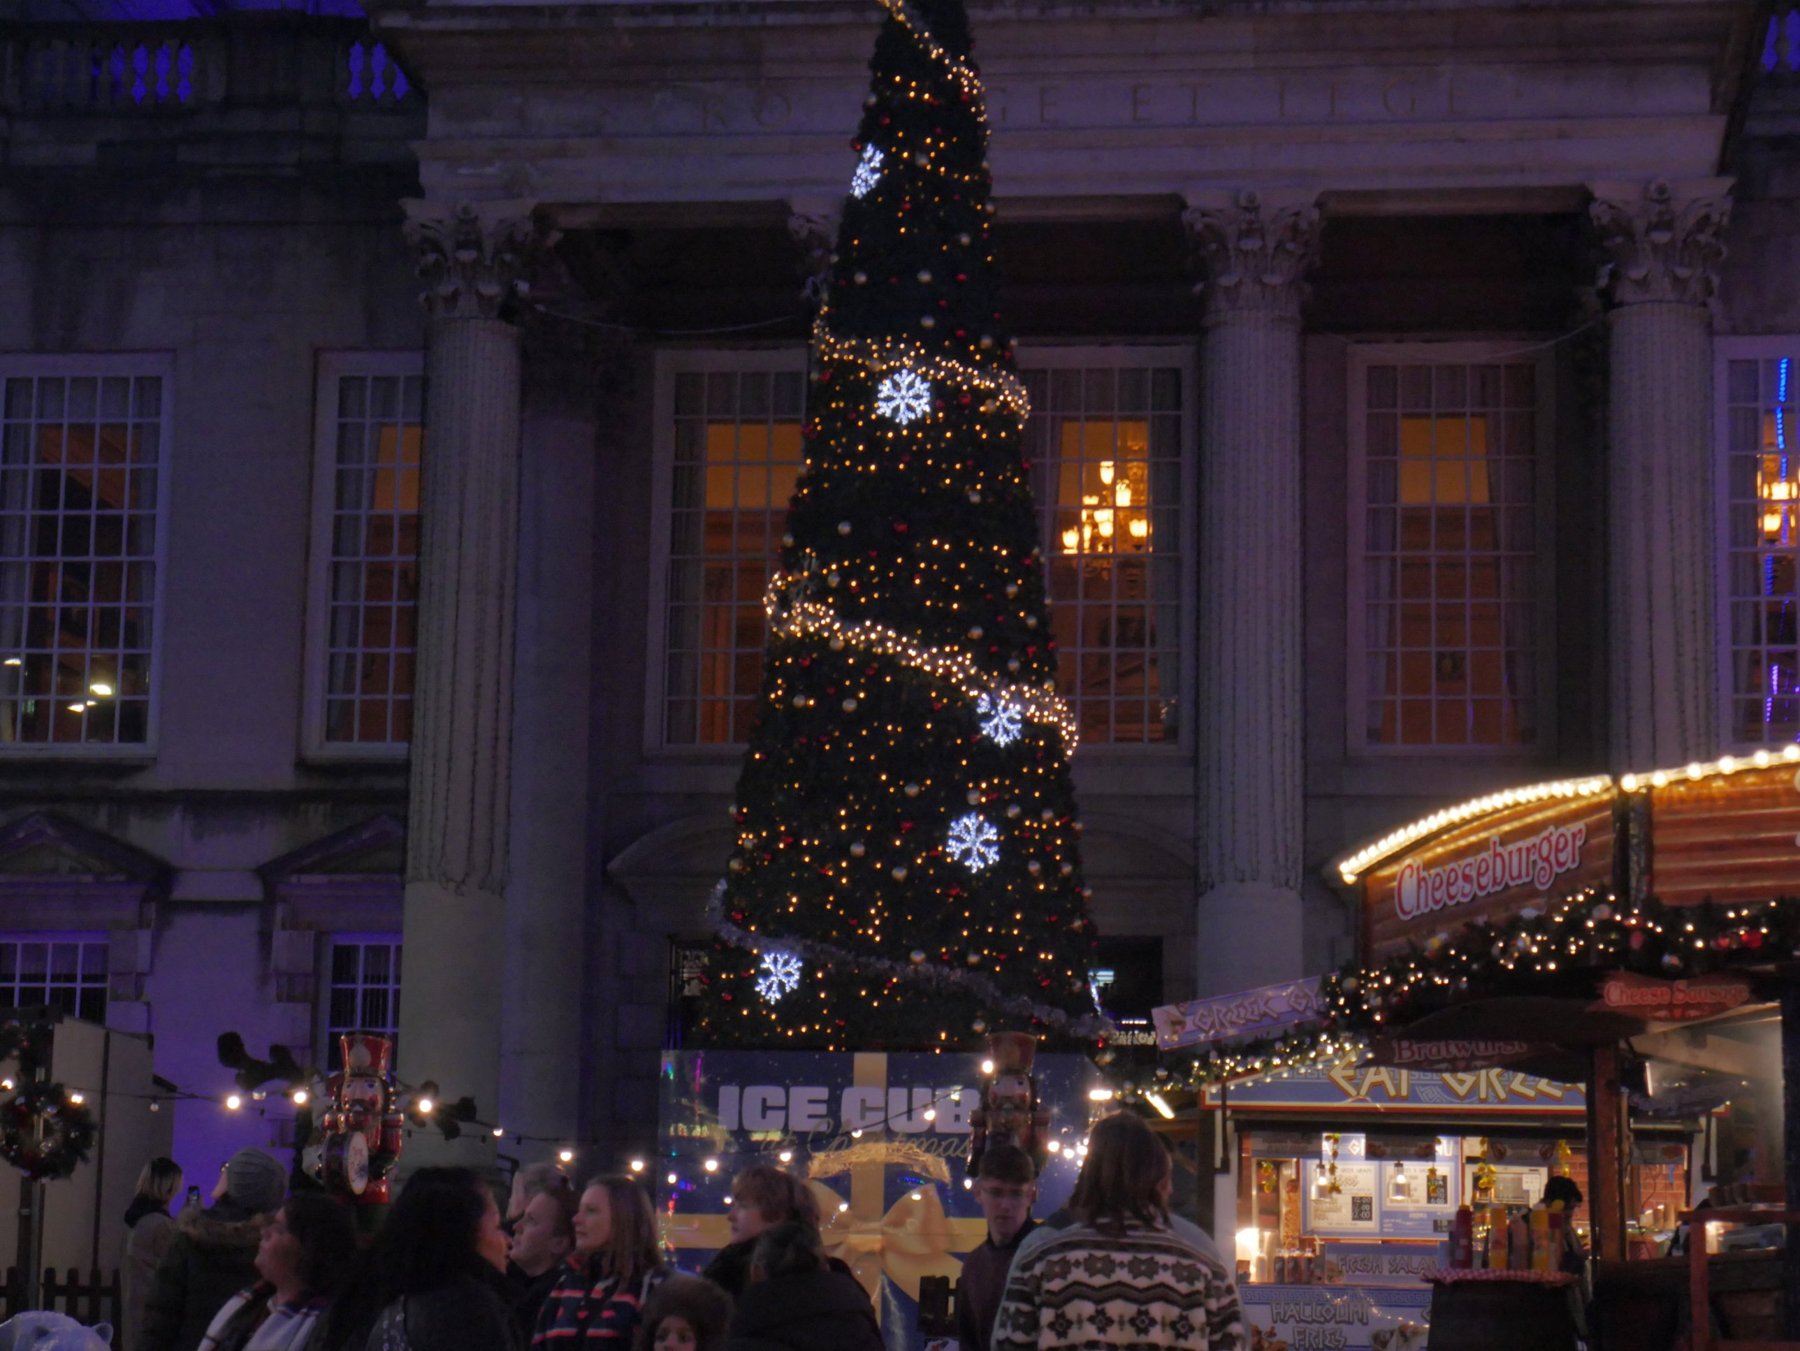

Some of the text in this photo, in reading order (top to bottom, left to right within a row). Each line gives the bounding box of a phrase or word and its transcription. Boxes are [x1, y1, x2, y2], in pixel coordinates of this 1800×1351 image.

[1395, 823, 1586, 920] Cheeseburger
[1603, 980, 1750, 1008] Cheese Sausage
[1193, 996, 1280, 1033] GREEK
[1328, 1047, 1409, 1098] EAT
[718, 1085, 982, 1134] ICE CUB
[1336, 1255, 1385, 1274] FRESH
[1271, 1301, 1371, 1325] HALLOUMI
[1293, 1326, 1348, 1350] FRIES
